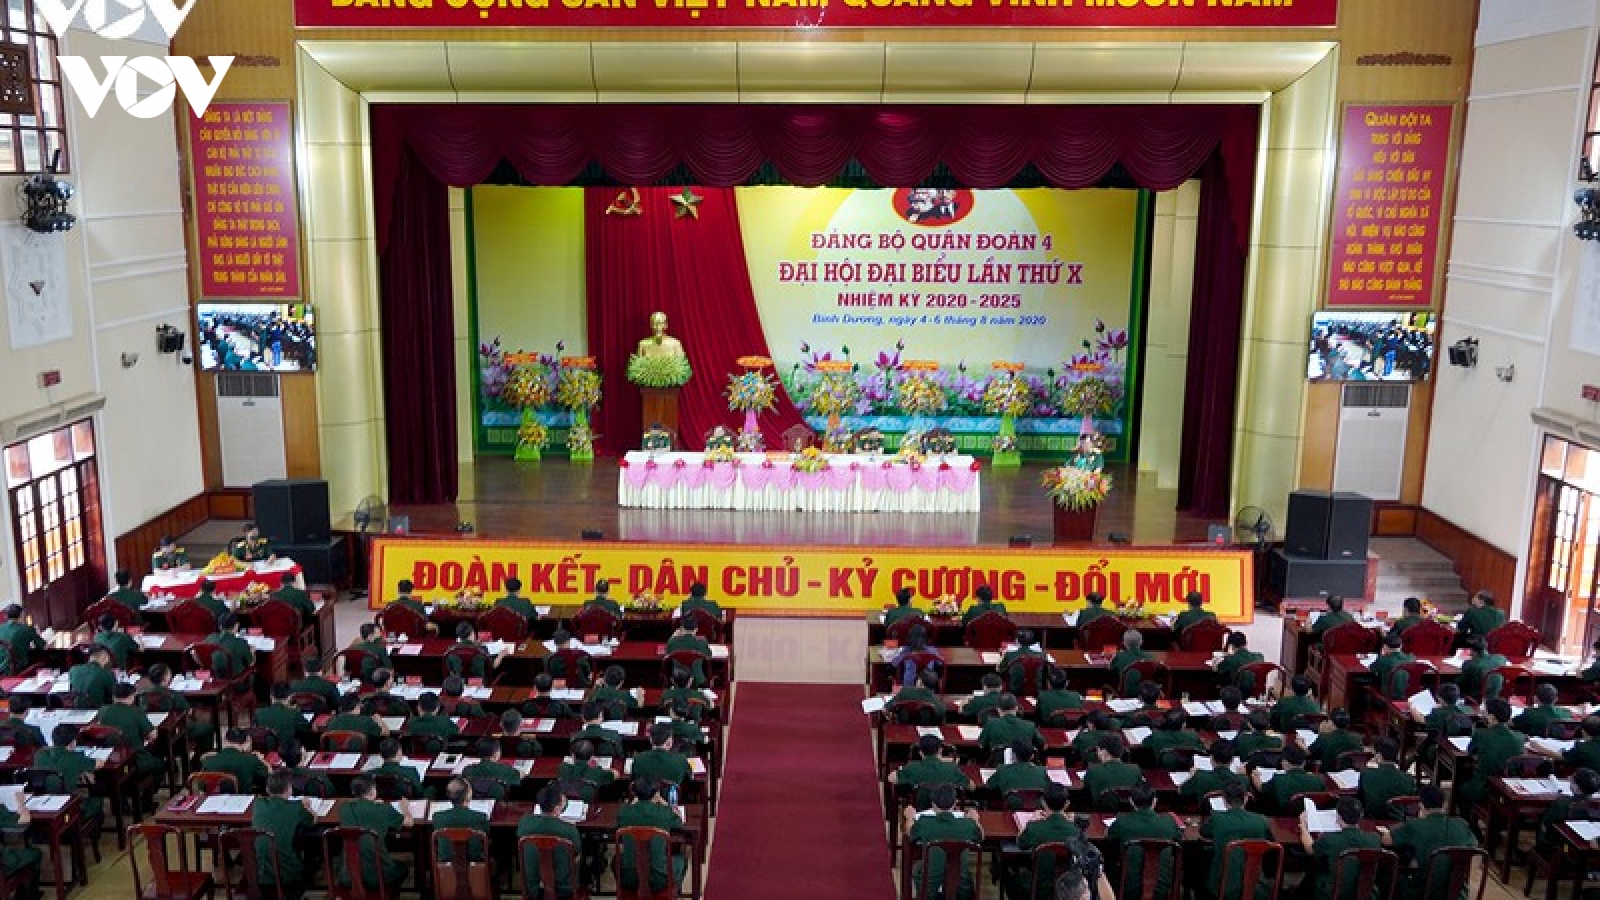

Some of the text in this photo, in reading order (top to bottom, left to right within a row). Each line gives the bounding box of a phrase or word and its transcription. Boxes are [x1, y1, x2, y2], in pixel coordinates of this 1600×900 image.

[811, 228, 1053, 253] ĐẢNG BỘ QUÂN ĐOÀN 4
[779, 262, 818, 287] ĐẠI
[823, 257, 863, 287] HỘI
[867, 262, 907, 287] ĐẠI
[911, 252, 962, 284] BIỂU
[1017, 257, 1065, 285] THỨ
[1066, 263, 1084, 285] X
[837, 289, 893, 310] NHIỆM
[926, 293, 967, 309] 2020
[979, 293, 1021, 309] 2025
[1018, 314, 1047, 325] 2020
[412, 554, 519, 592] ĐOÀN
[531, 553, 602, 593] KẾT
[629, 557, 709, 595] DÂN
[721, 555, 801, 598] CHỦ
[829, 557, 879, 599] KỶ
[891, 565, 1027, 602] CƯƠNG
[1054, 557, 1121, 603] ĐỔI
[1135, 565, 1211, 604] MỚI
